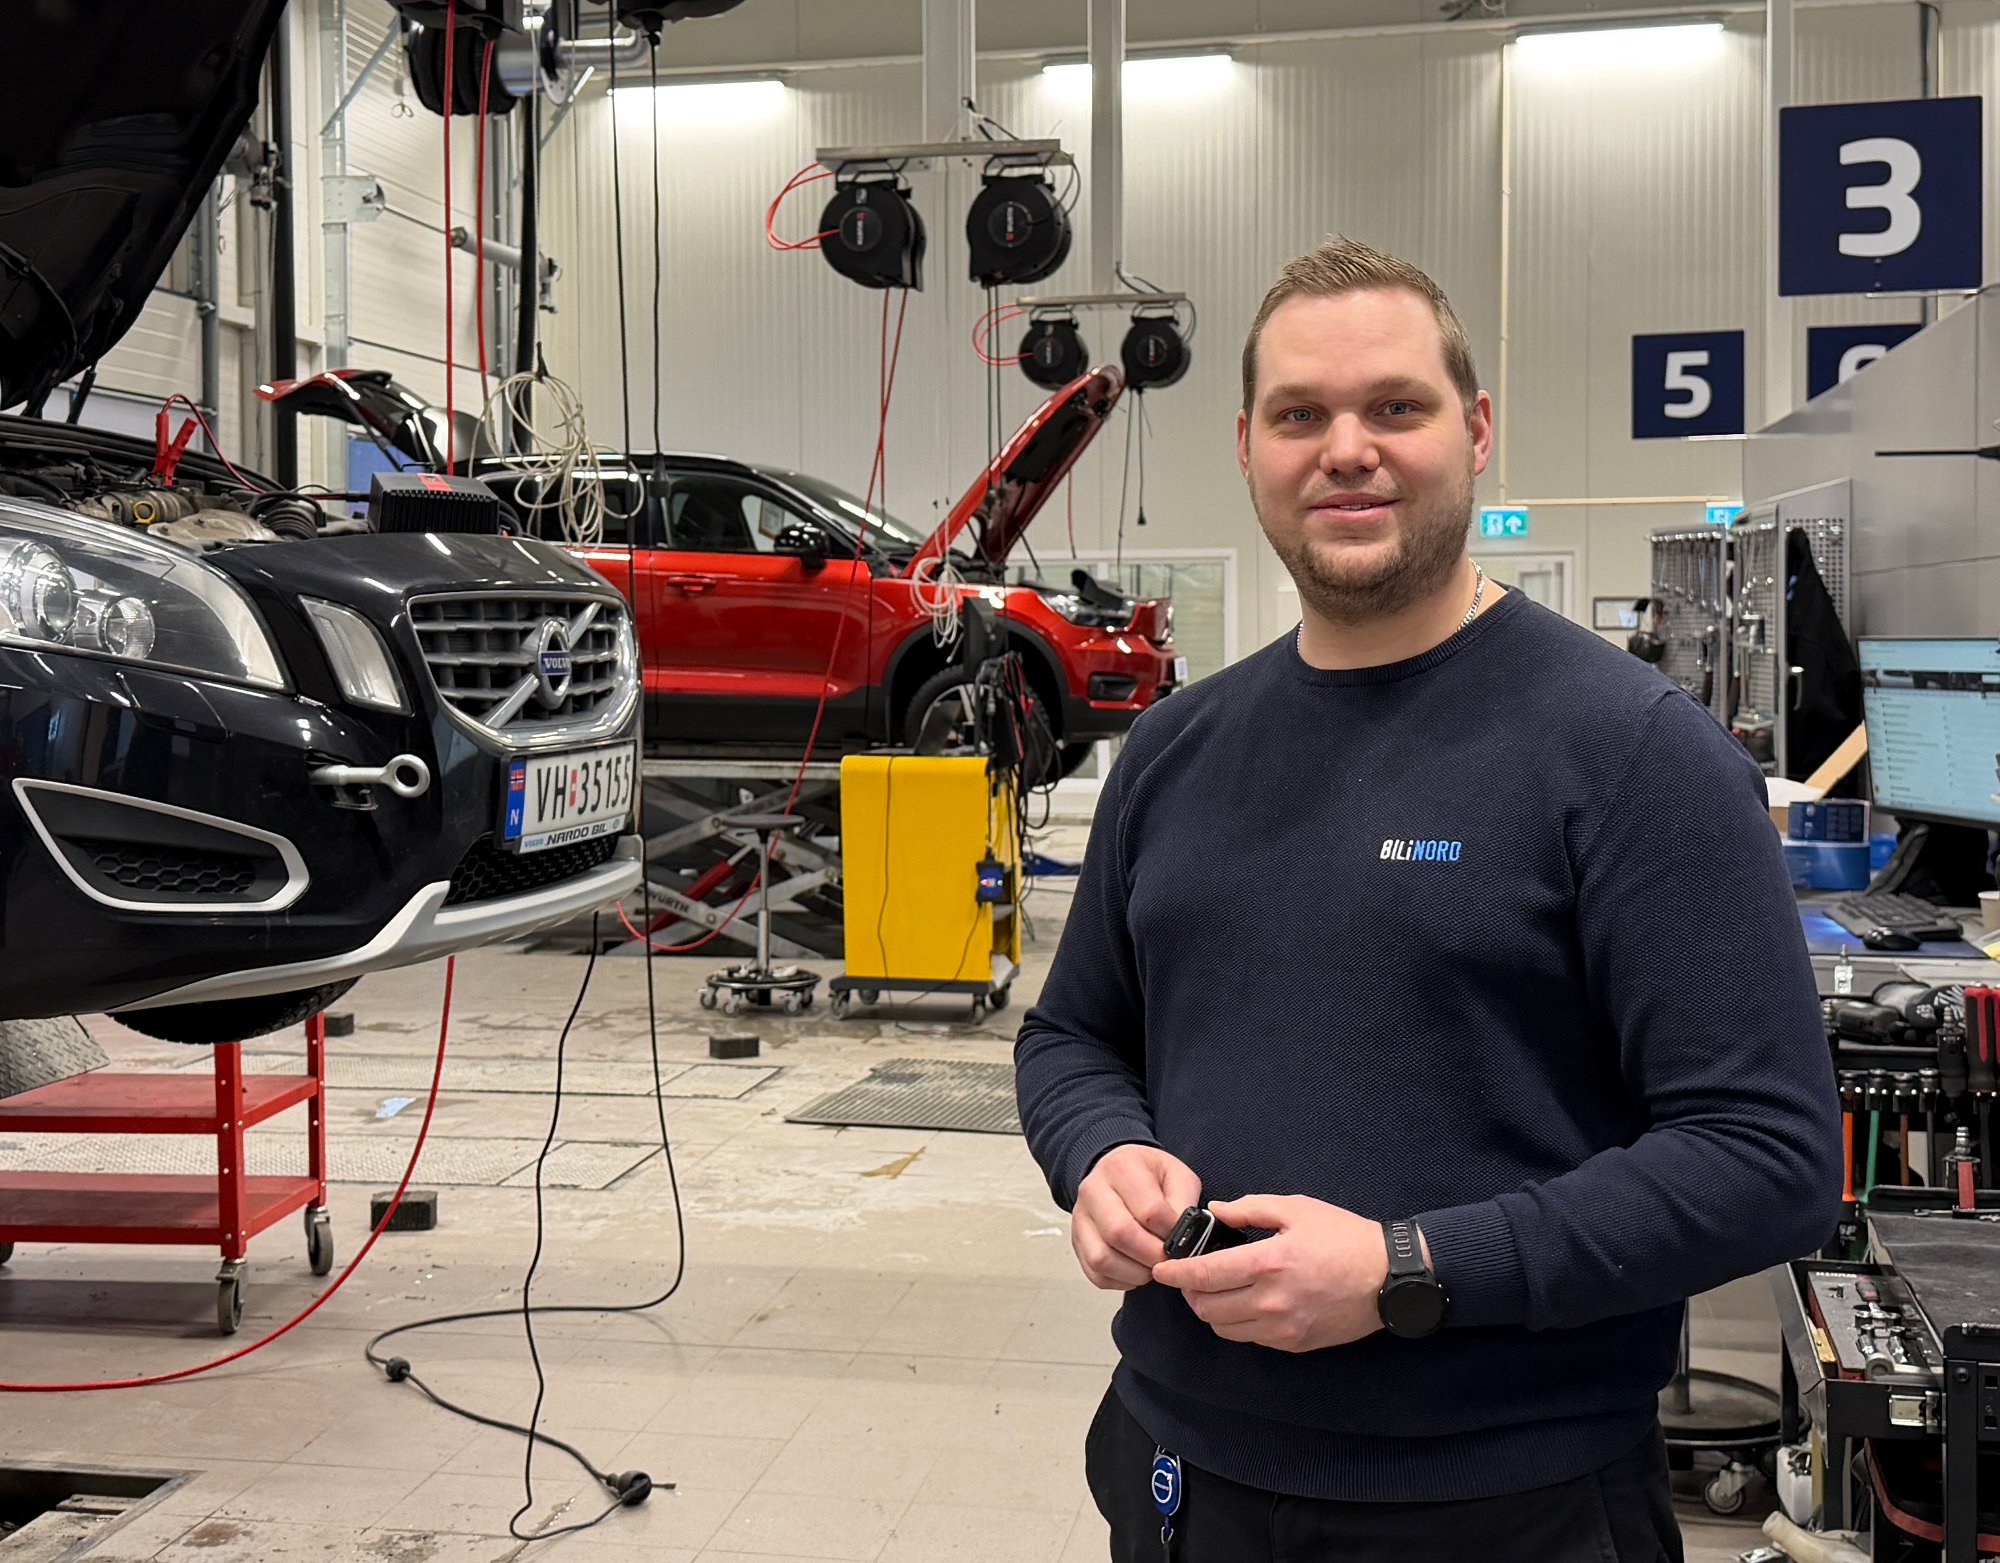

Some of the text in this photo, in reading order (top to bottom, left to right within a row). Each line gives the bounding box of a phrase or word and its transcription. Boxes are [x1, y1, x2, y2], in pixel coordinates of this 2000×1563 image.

[1838, 137, 1922, 257] 3
[1664, 350, 1712, 419] 5
[510, 809, 520, 826] N
[537, 755, 631, 823] VH 35155
[545, 826, 589, 846] NARDO
[591, 823, 608, 835] BIL
